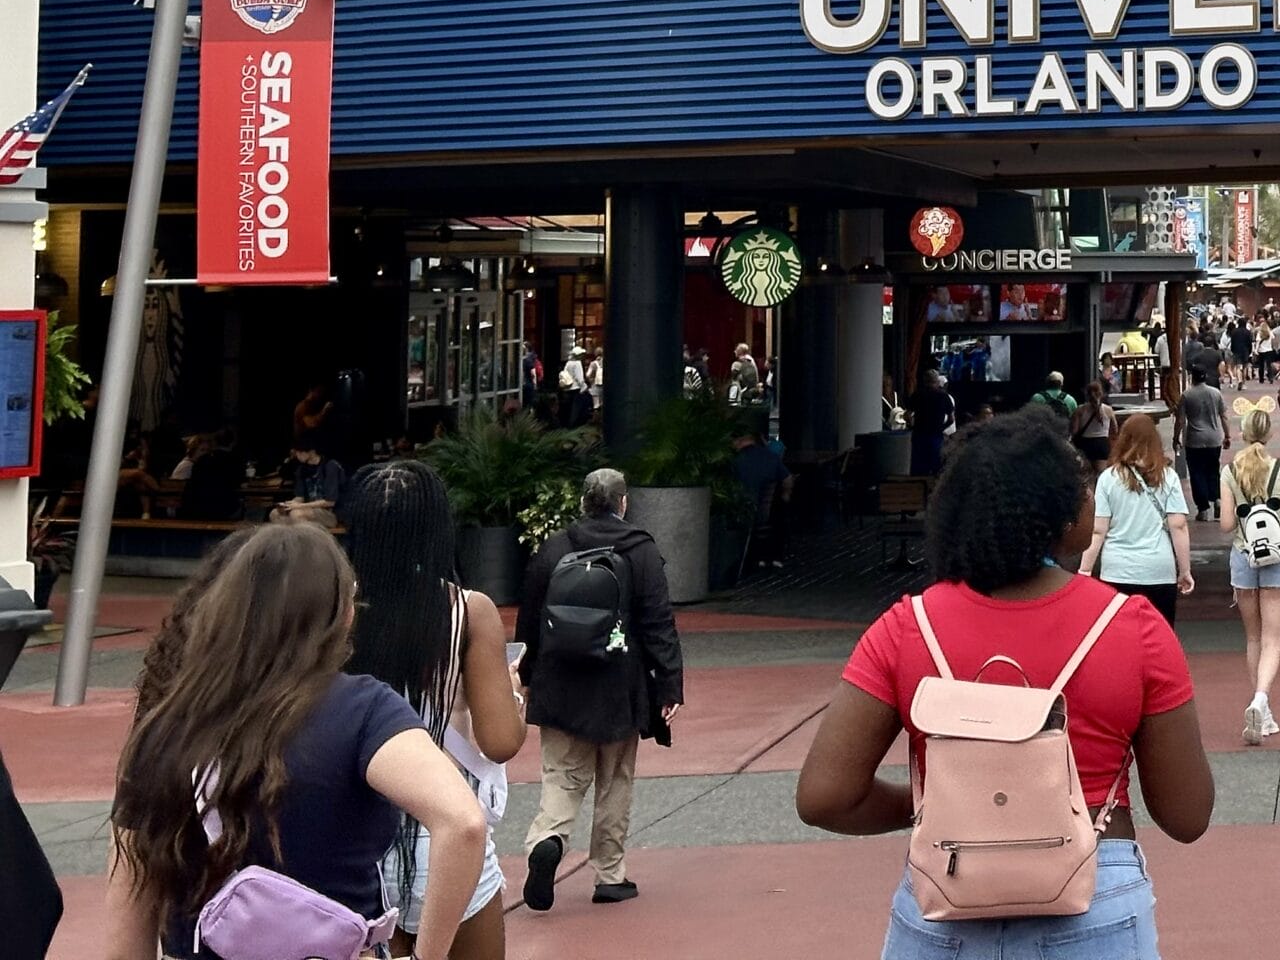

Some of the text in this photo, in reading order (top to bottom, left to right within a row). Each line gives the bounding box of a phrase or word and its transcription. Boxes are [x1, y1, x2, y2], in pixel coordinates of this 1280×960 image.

[865, 43, 1258, 121] ORLANDO
[257, 50, 293, 258] SEAFOOD
[238, 171, 256, 272] FAVORITES
